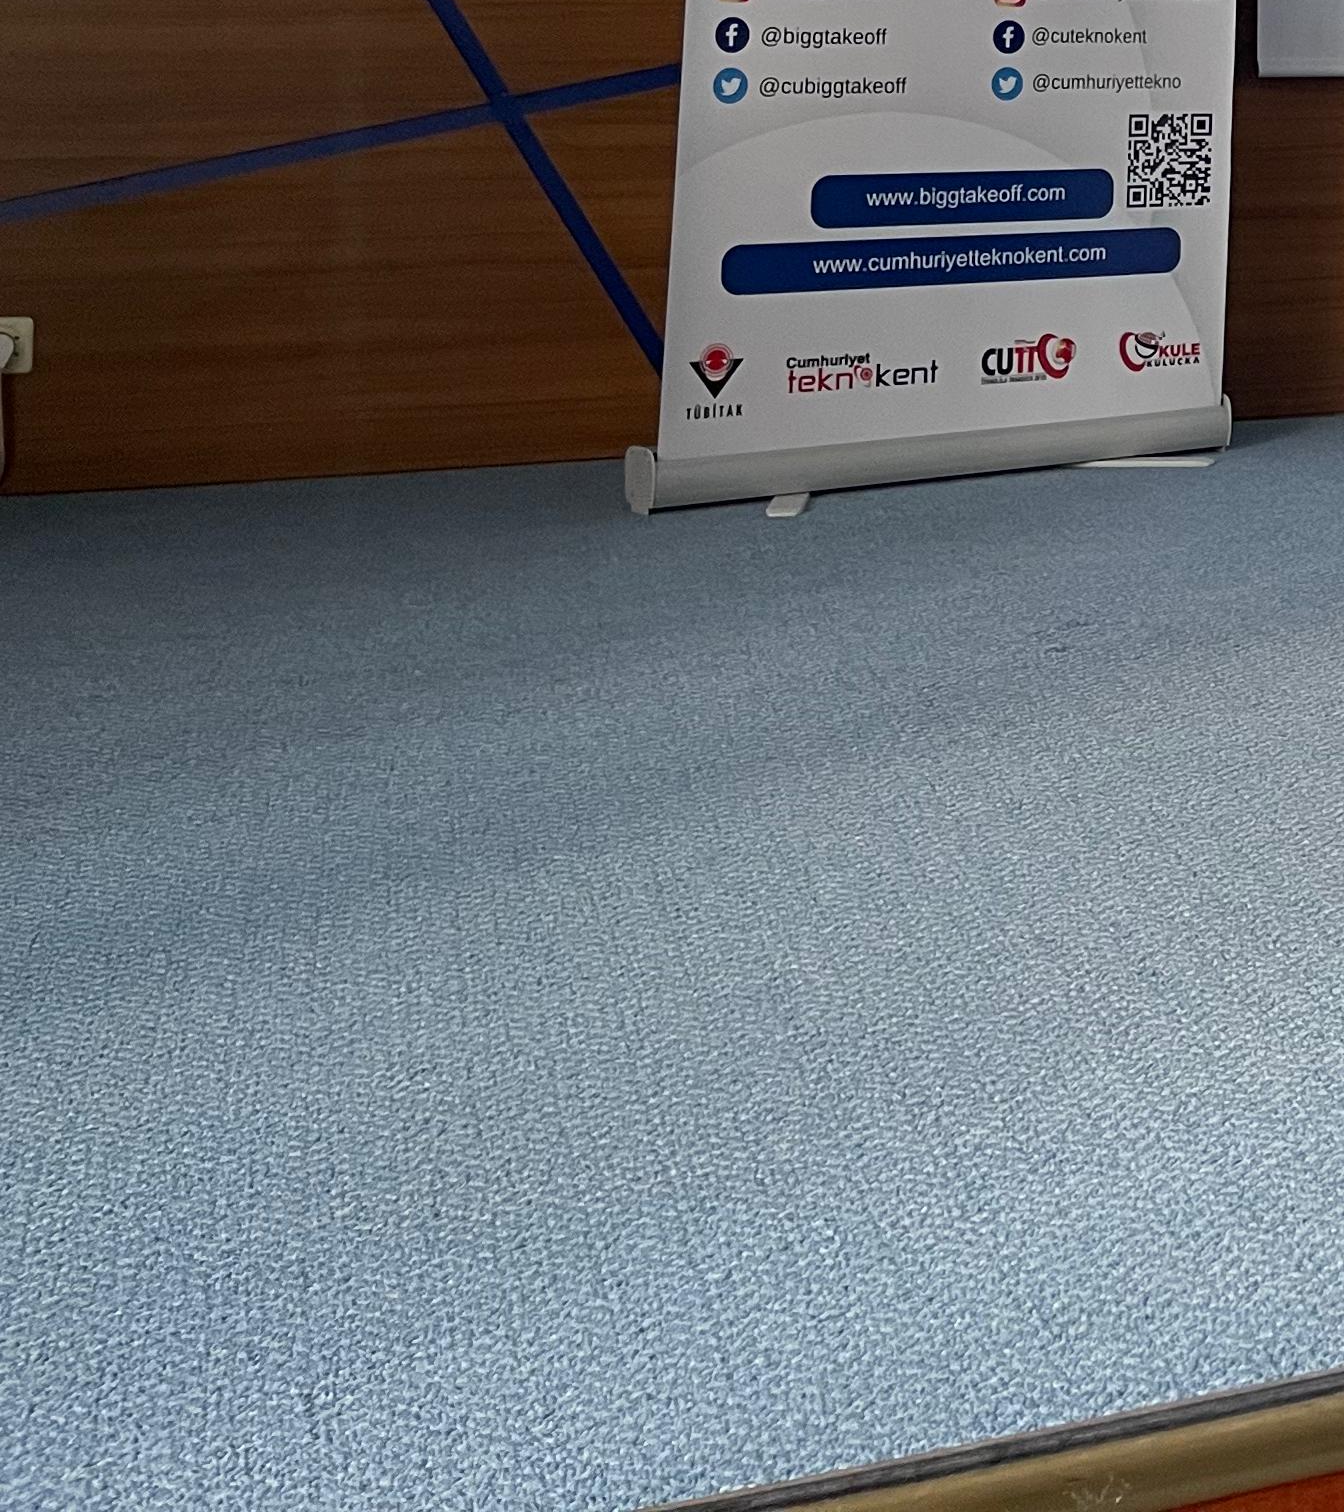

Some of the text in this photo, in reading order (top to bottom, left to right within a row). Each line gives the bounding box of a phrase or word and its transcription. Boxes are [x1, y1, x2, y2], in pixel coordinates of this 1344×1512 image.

[761, 26, 887, 49] @biggtakeoff
[1031, 27, 1148, 46] @cuteknokent
[758, 76, 907, 98] @cubiggtakeoff
[1032, 73, 1182, 93] @cumhuriyettekno
[866, 183, 1066, 210] www.biggtakeoff.com
[813, 244, 1106, 275] www.cumhuriyetteknokent.com
[786, 353, 870, 369] Cumhuriyet
[686, 403, 744, 420] TÜBİTAK
